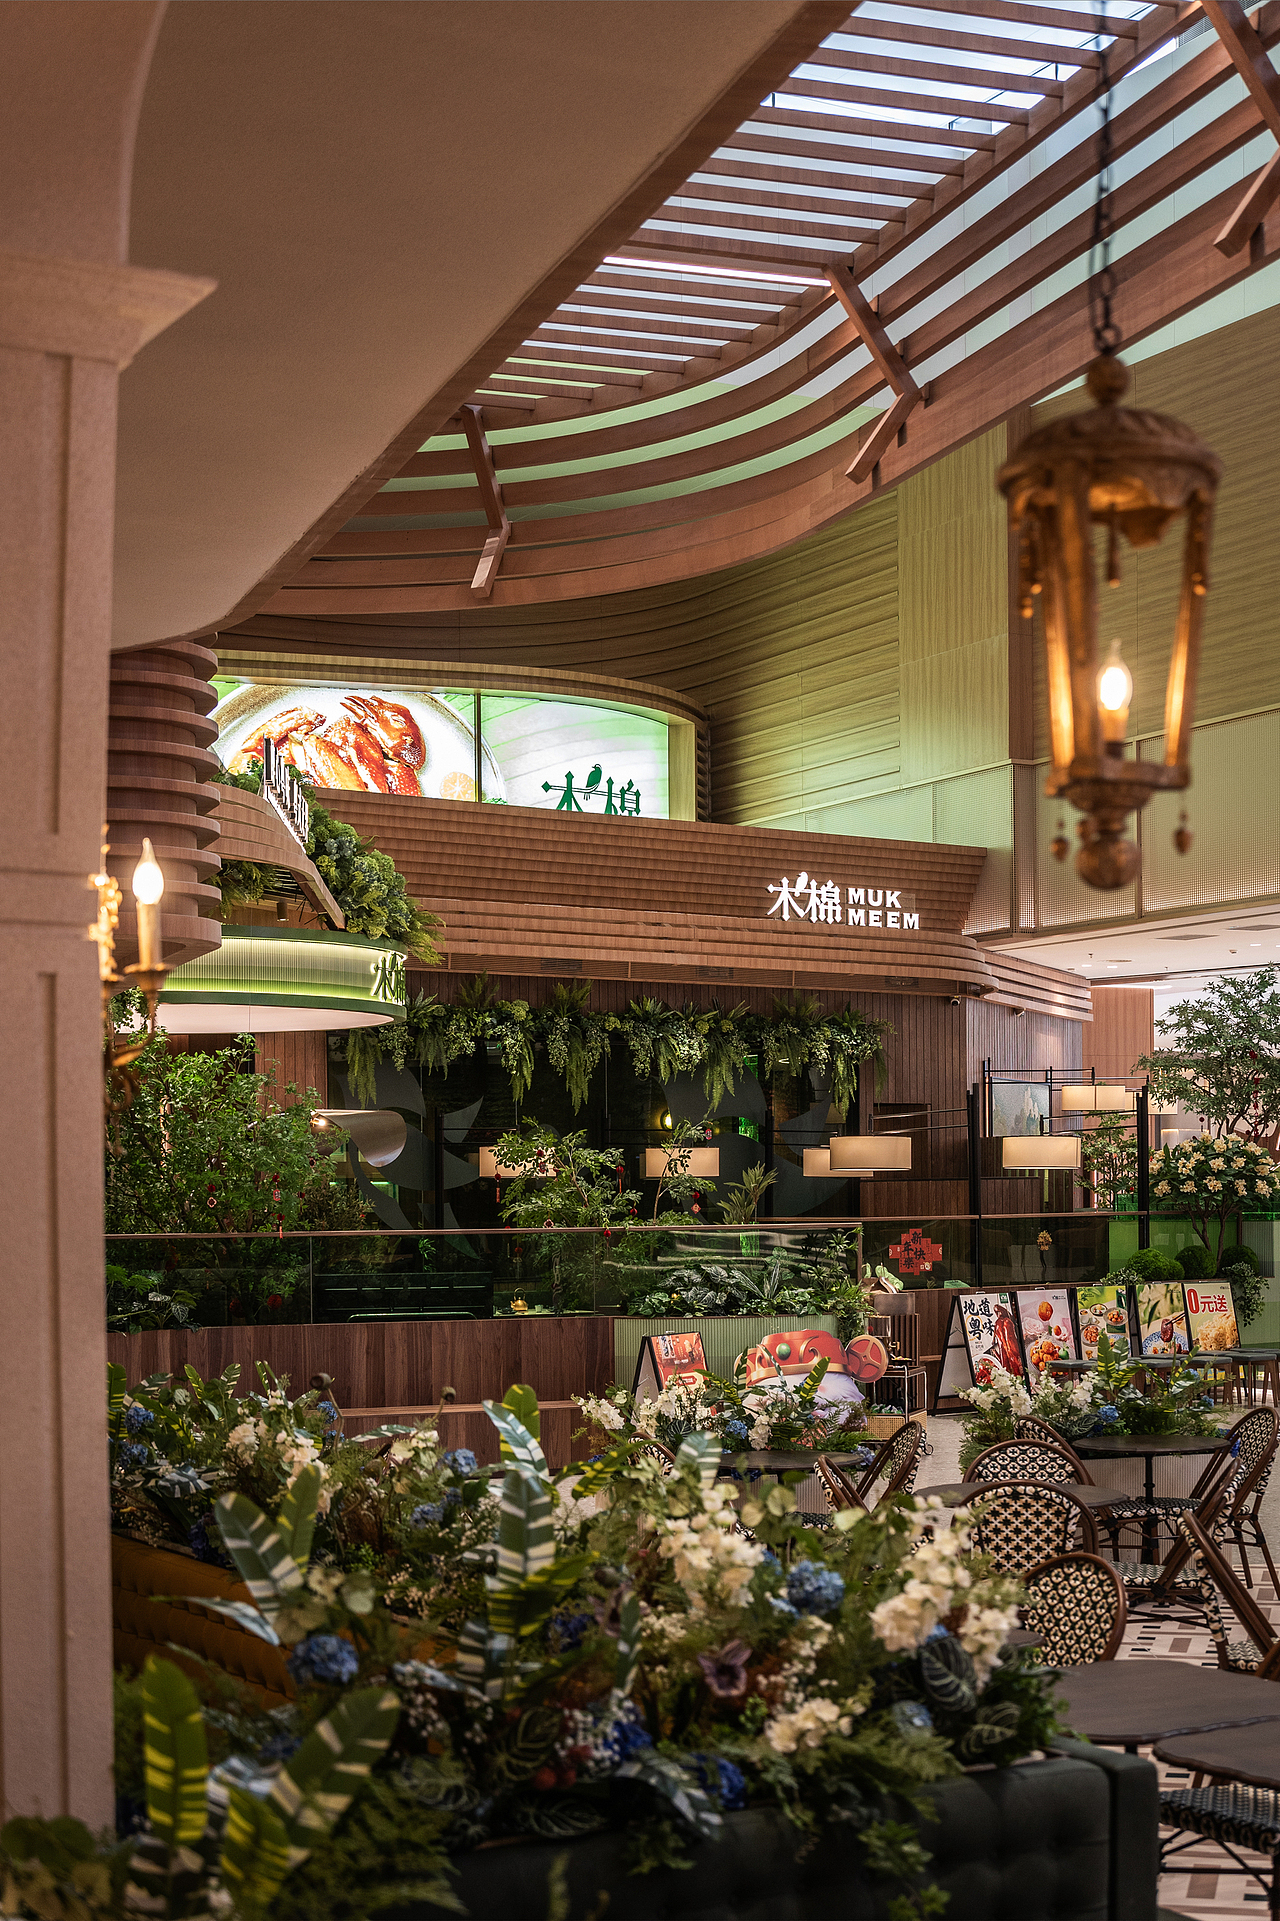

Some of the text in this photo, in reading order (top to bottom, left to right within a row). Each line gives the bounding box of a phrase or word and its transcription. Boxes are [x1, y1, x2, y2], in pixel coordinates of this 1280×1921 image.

[765, 876, 842, 925] 木棉
[847, 887, 902, 909] MUK
[847, 908, 920, 930] MEEM
[963, 1297, 994, 1318] 地道
[1187, 1288, 1229, 1315] 0元送
